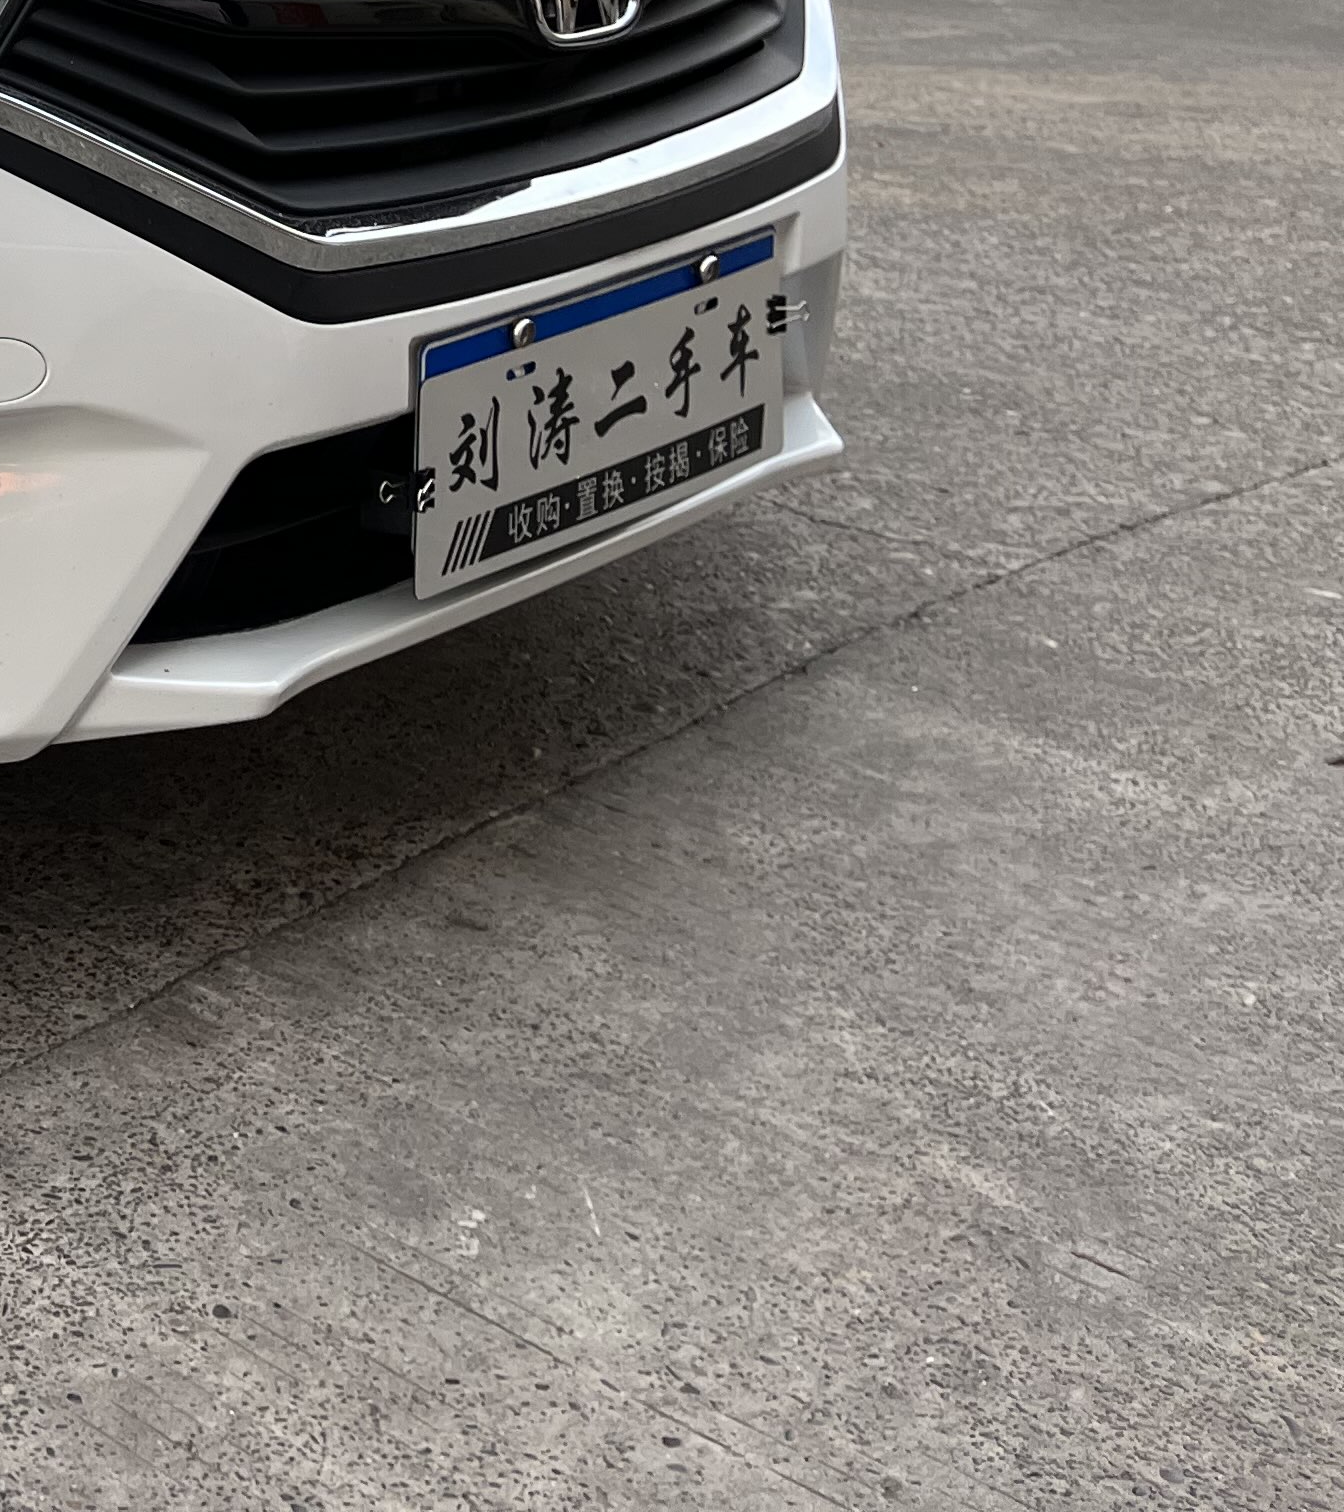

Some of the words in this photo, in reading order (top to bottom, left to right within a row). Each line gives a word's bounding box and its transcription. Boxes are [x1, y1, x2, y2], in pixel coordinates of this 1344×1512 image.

[449, 304, 759, 491] 刘涛二手车
